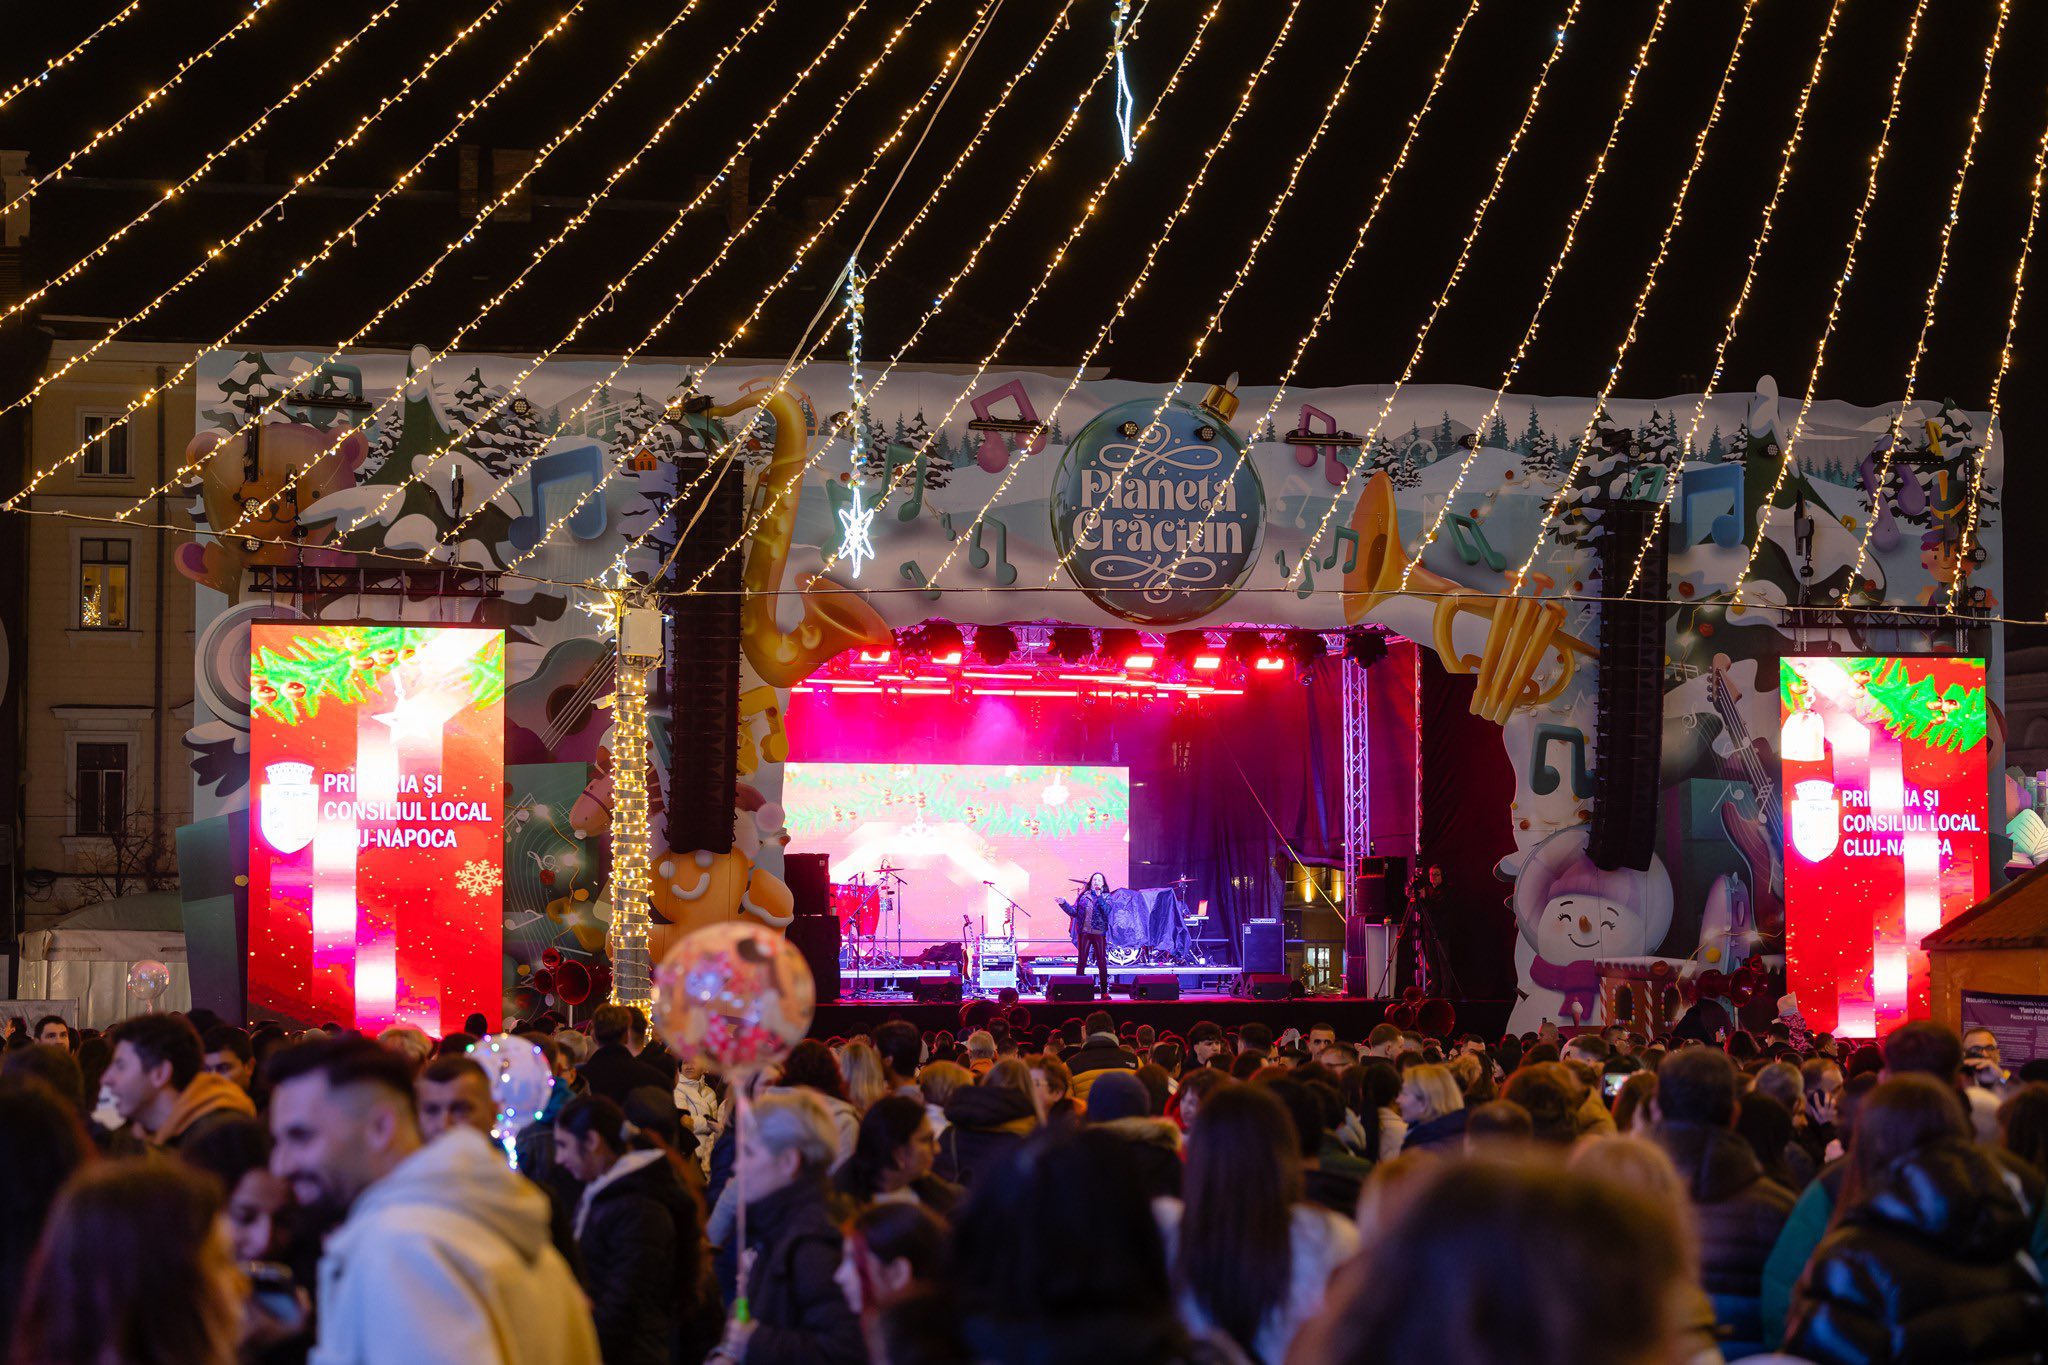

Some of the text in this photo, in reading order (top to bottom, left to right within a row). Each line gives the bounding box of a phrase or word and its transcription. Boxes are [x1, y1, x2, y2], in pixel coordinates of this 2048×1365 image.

[1081, 469, 1237, 512] Planeta
[1072, 510, 1243, 554] Crăciun
[1842, 789, 1920, 807] PRIIA
[323, 801, 492, 822] CONSILIUL LOCAL
[1842, 814, 1980, 832] CONSILIUL LOCAL
